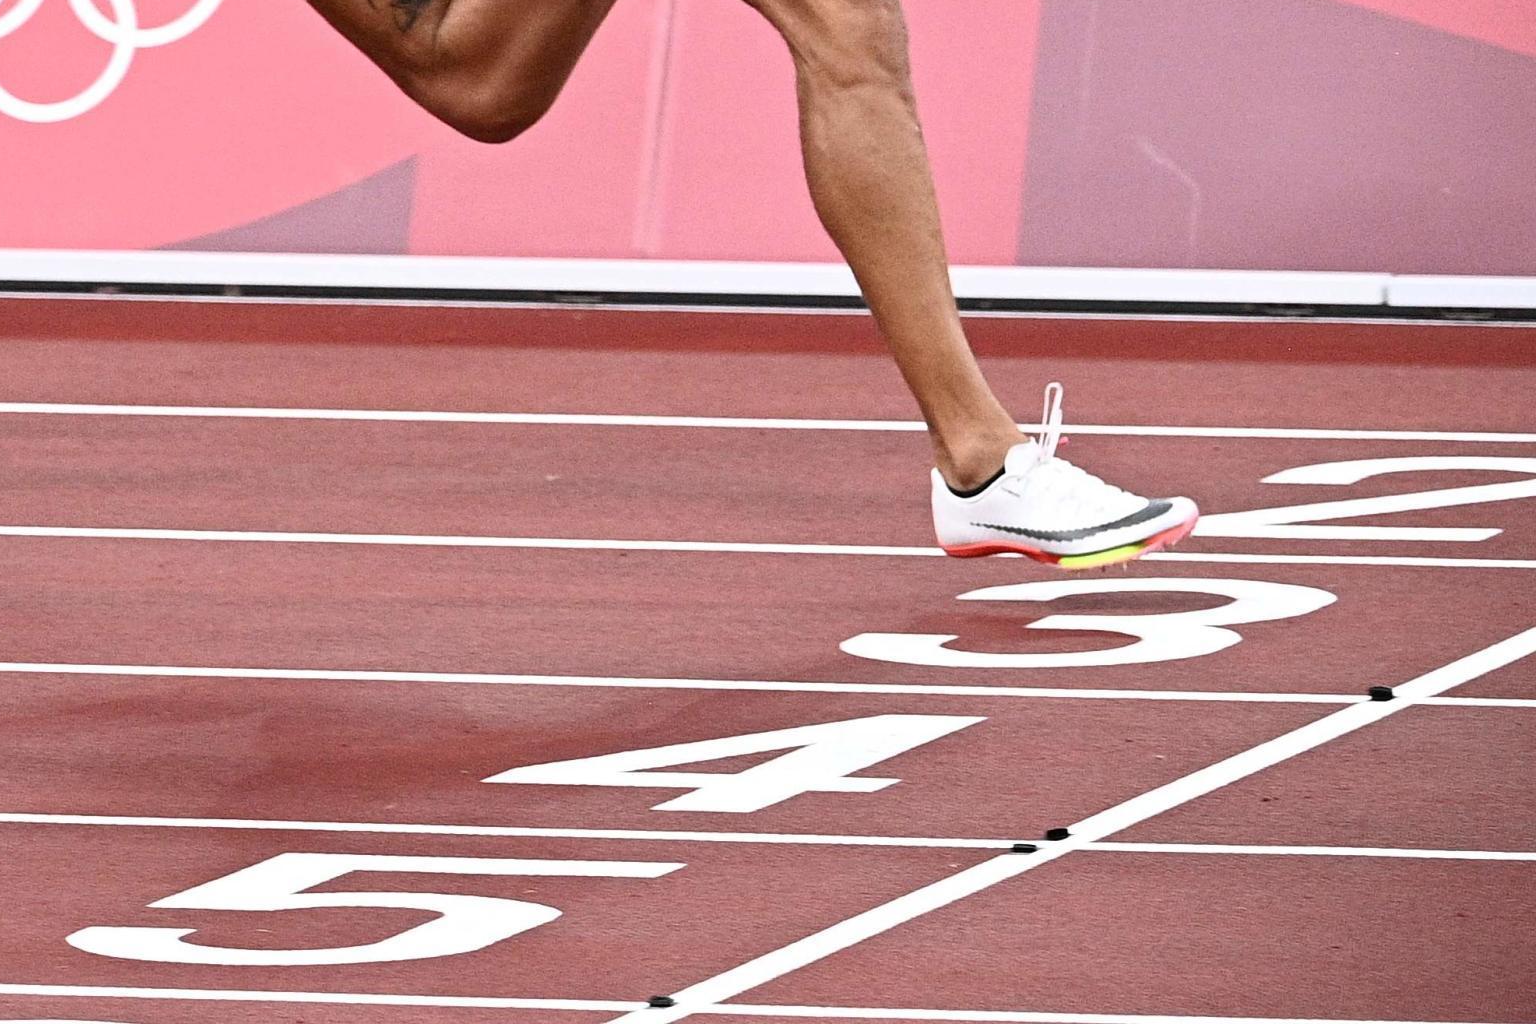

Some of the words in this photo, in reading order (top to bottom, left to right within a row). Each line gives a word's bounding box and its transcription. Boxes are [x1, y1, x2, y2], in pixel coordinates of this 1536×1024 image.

[839, 576, 1338, 668] 3
[482, 714, 990, 813] 4
[65, 852, 689, 966] 5
